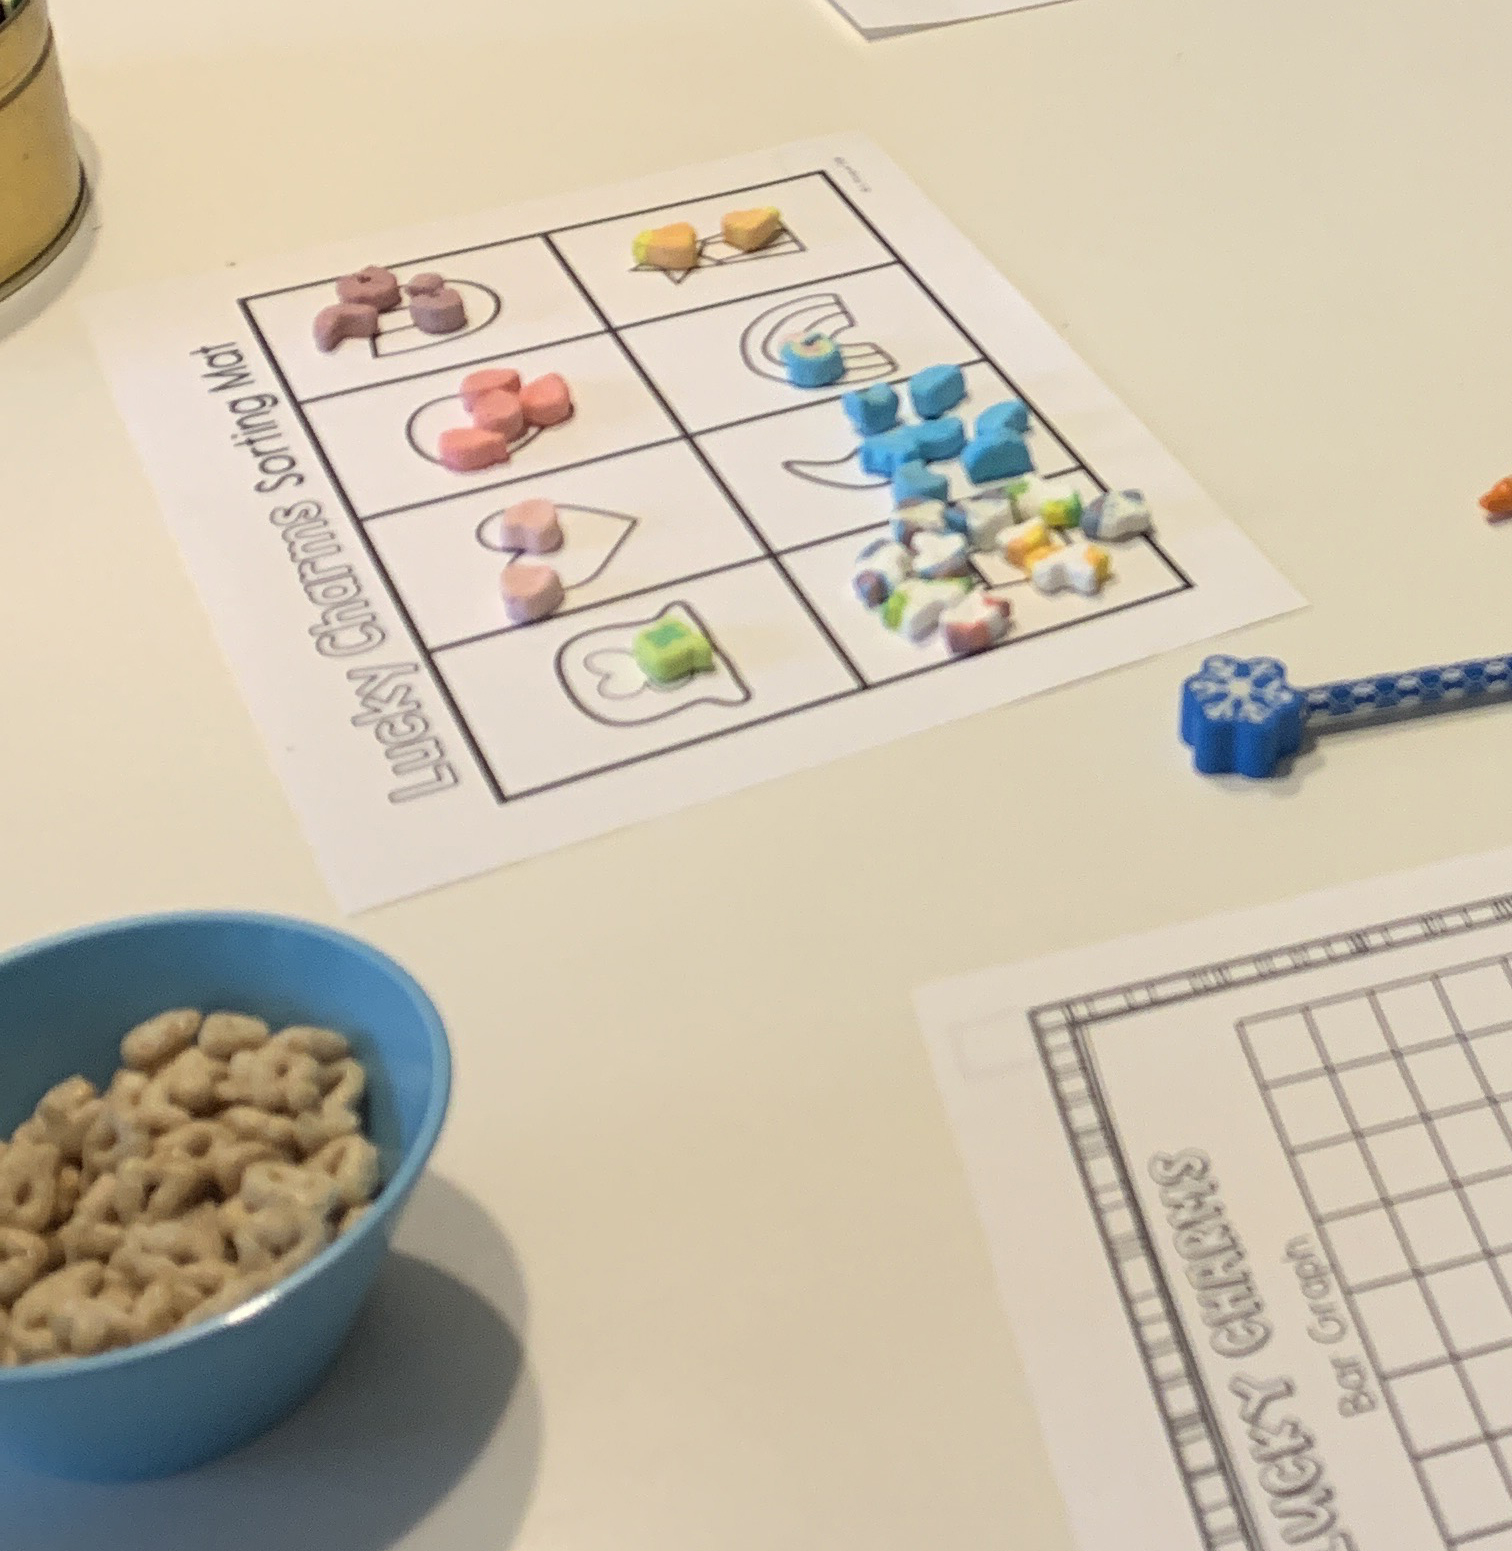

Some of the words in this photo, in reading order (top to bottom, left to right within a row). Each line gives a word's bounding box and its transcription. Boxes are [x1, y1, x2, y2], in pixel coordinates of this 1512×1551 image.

[190, 341, 256, 394] Mat
[230, 393, 304, 494] Sorting
[269, 499, 386, 657] Charms
[346, 661, 458, 804] Lucky
[1147, 1147, 1273, 1358] CHARMS
[1281, 1233, 1349, 1345] Graph
[1329, 1352, 1379, 1418] Bar
